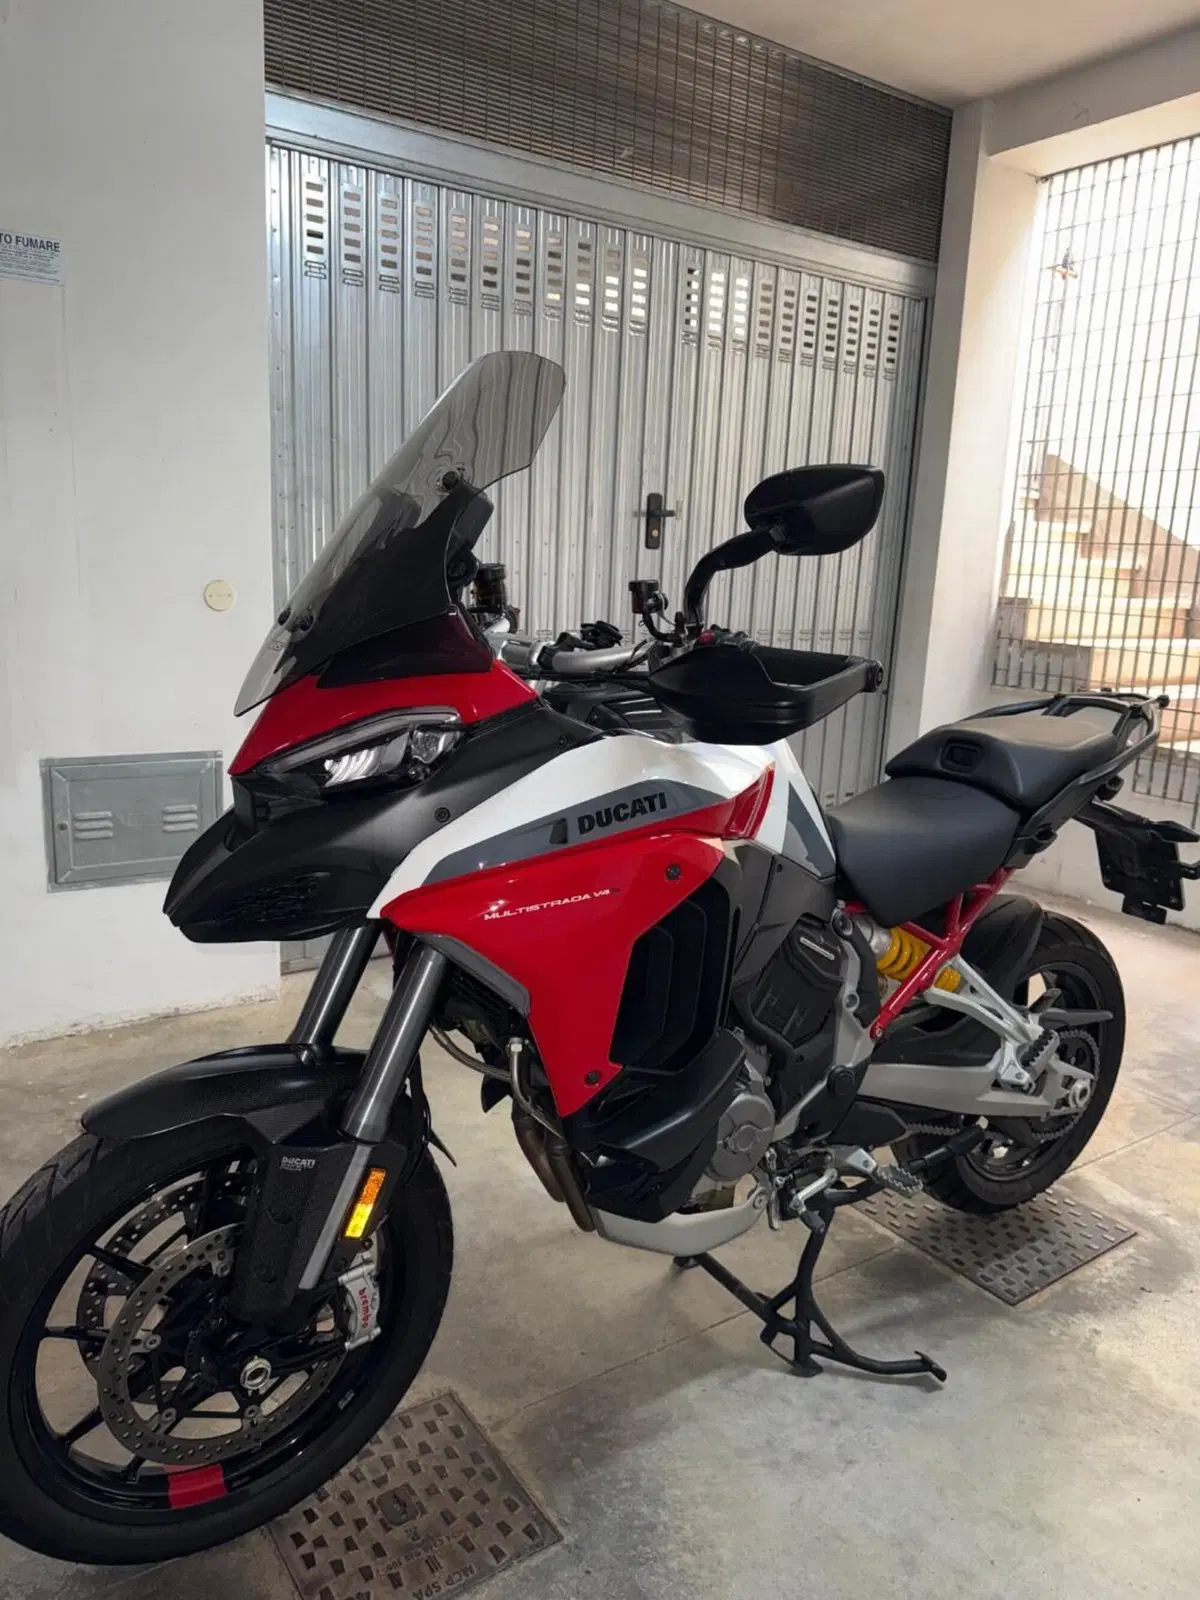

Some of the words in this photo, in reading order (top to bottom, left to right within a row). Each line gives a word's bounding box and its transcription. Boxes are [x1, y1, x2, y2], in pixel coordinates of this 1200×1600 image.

[15, 235, 60, 253] FUMARE
[577, 792, 668, 835] DUCATI
[484, 894, 591, 921] MULTISTRADA
[281, 1155, 316, 1167] DUCATI
[358, 1287, 370, 1329] brembo
